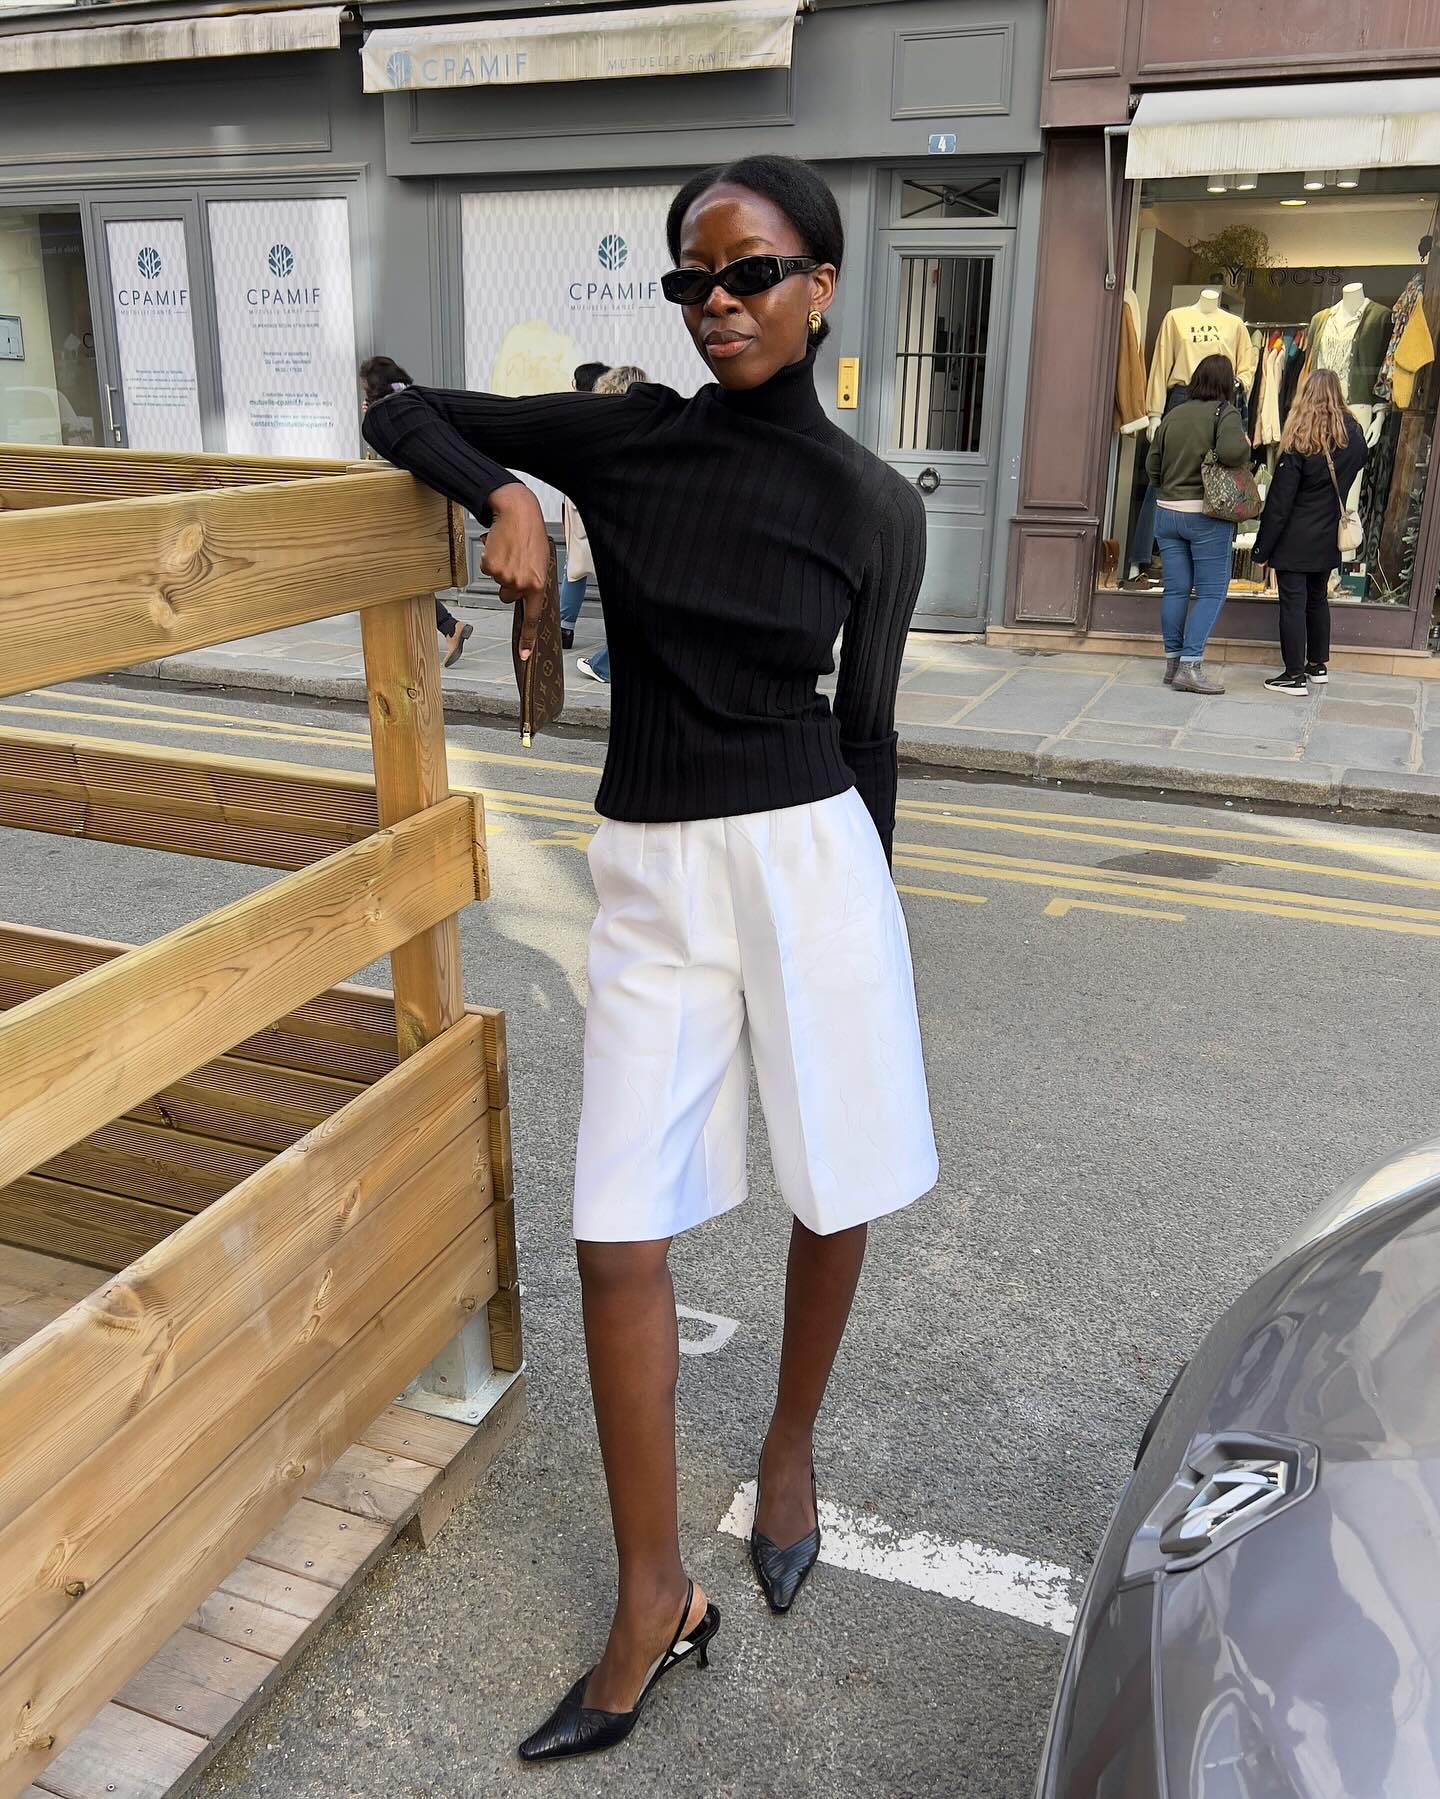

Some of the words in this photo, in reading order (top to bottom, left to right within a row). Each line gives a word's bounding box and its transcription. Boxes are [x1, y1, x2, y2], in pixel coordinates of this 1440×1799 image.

[422, 52, 527, 81] CPAMIF
[607, 55, 681, 70] MUTUELLE
[938, 135, 946, 152] 4
[118, 290, 188, 306] CPAMIF
[247, 288, 320, 305] CPAMIF
[569, 282, 658, 301] CPAMIF
